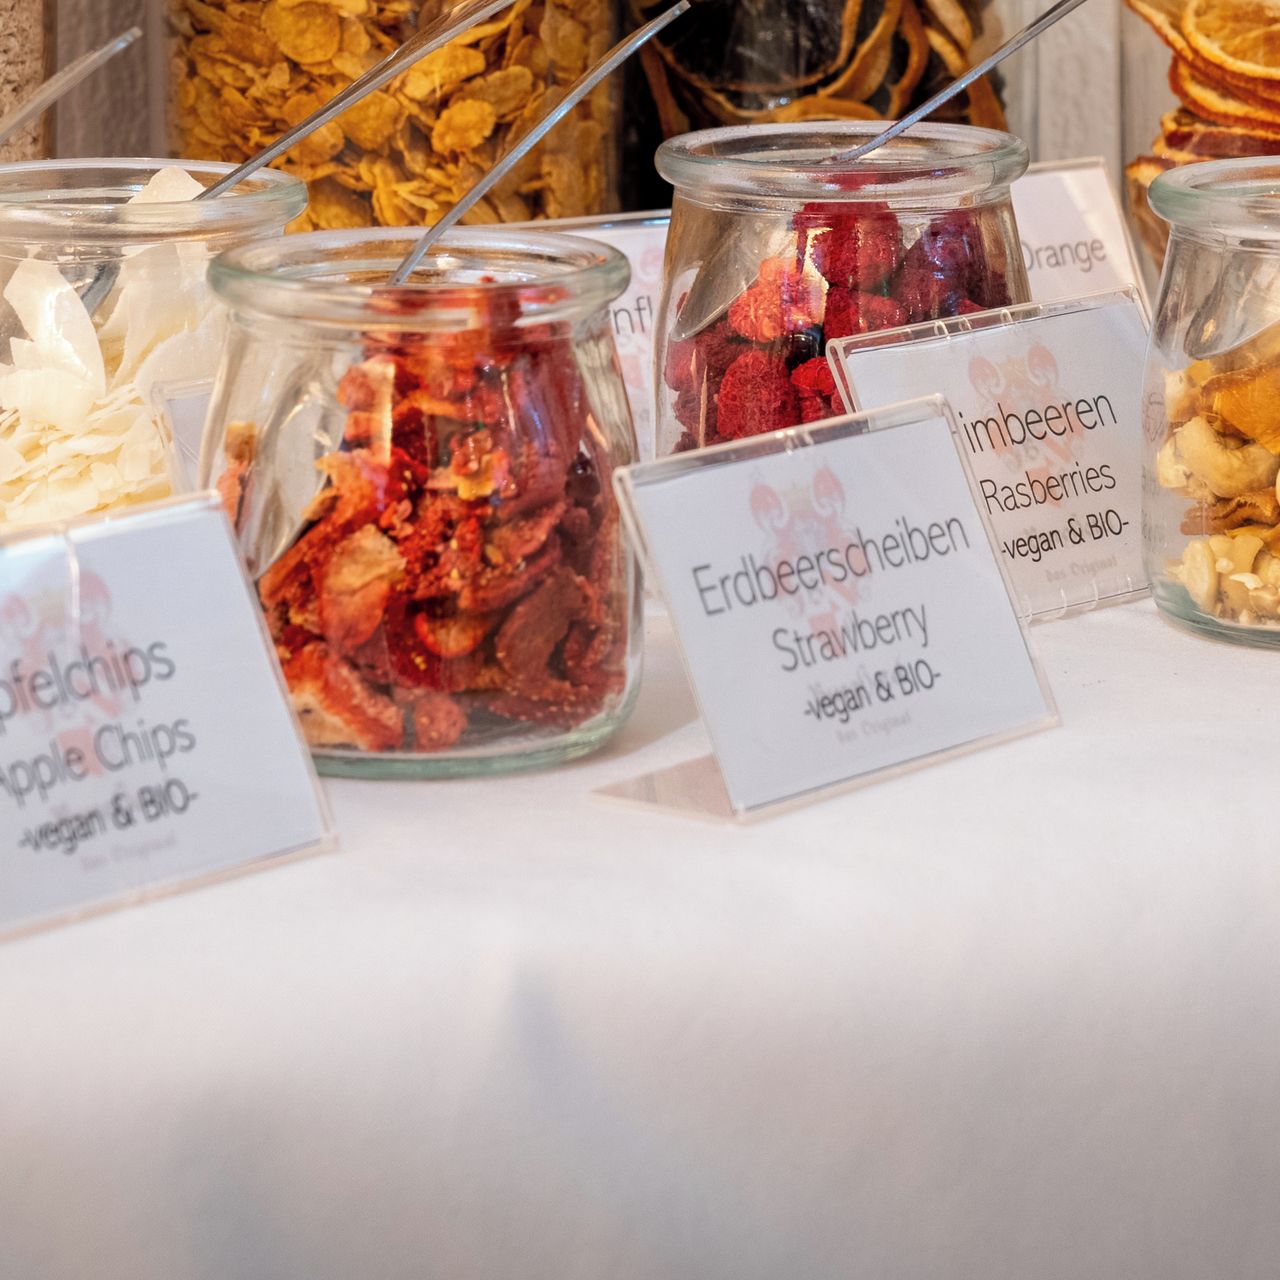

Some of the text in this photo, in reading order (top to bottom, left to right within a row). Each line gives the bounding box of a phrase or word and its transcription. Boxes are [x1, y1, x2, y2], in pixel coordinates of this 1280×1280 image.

[958, 394, 1117, 453] imbeeren
[979, 461, 1117, 515] Rasberries
[1001, 508, 1130, 563] -vegan & BIO-
[692, 516, 970, 617] Erdbeerscheiben
[772, 604, 928, 672] Strawberry
[804, 659, 941, 725] -vegan & BIO-
[93, 717, 197, 773] Chips
[111, 791, 137, 830] &
